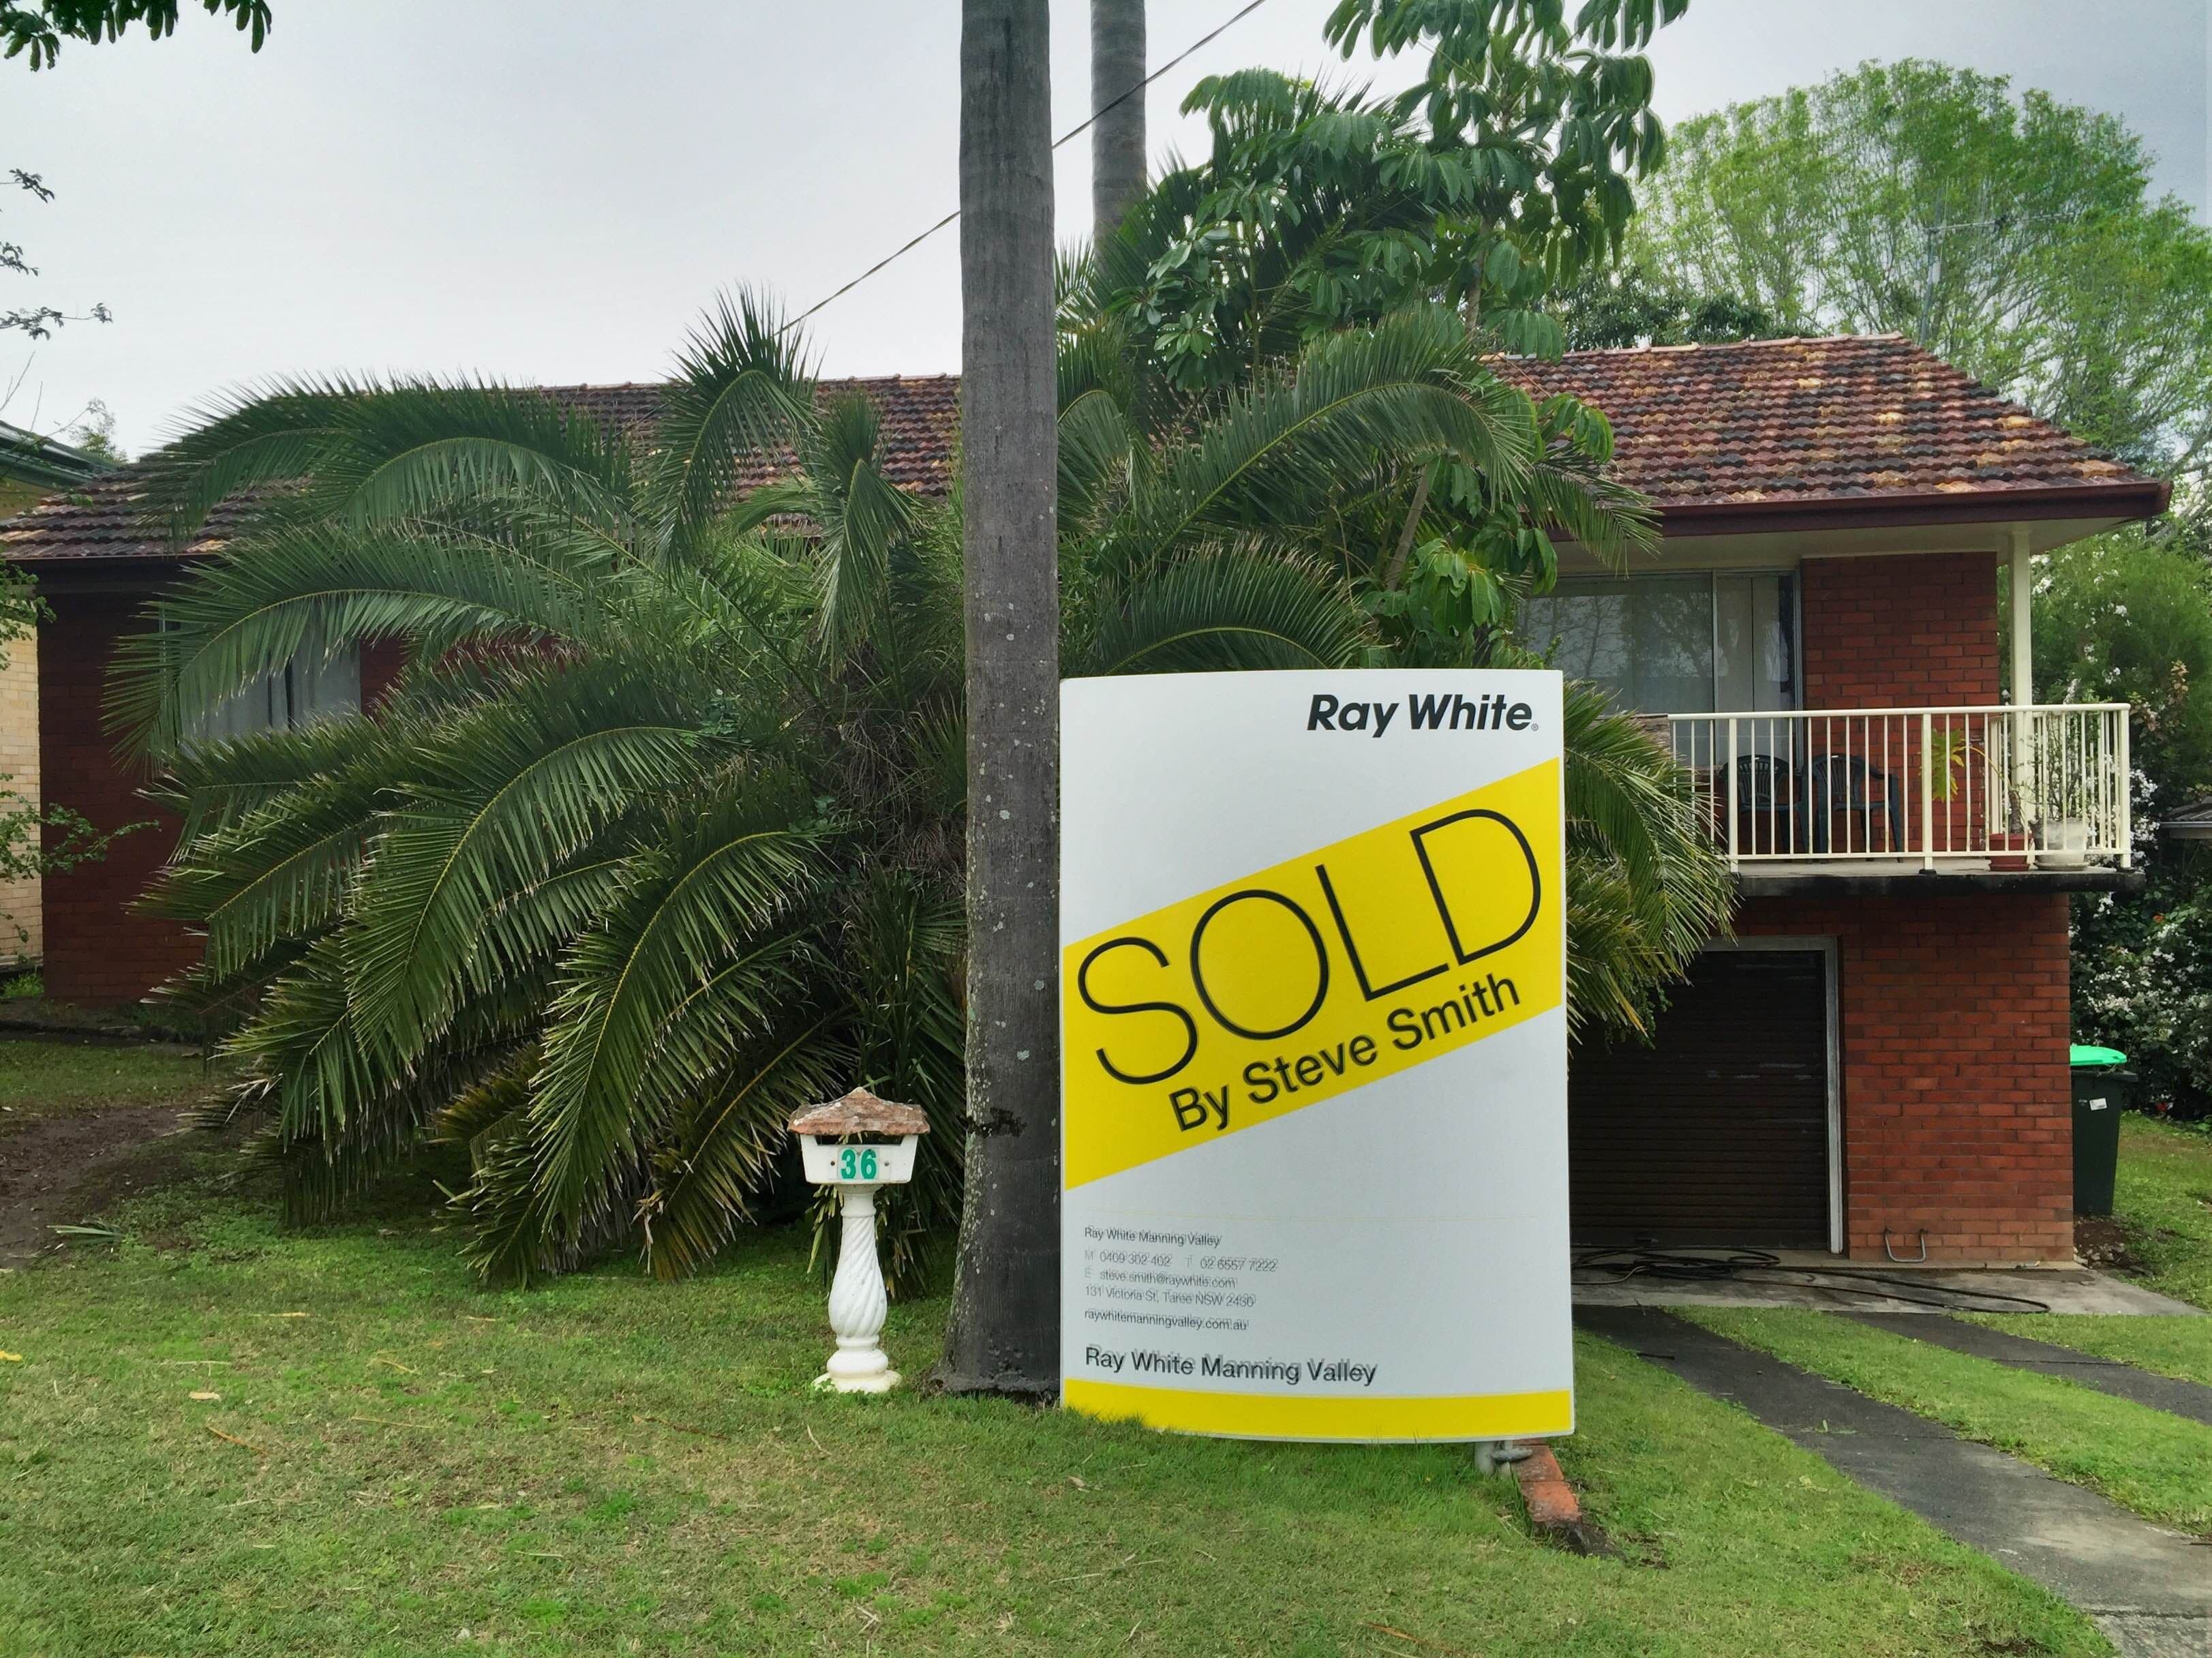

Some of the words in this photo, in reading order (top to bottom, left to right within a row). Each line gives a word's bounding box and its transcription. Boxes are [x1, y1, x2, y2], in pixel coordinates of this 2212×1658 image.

[1307, 694, 1399, 738] Ray
[1078, 809, 1541, 1085] SOLD
[1168, 1085, 1231, 1132] By
[1243, 1034, 1378, 1104] Steve
[1387, 972, 1521, 1051] Smith
[840, 1148, 877, 1179] 36
[1085, 1226, 1103, 1241] Ray
[1106, 1228, 1136, 1241] White
[1139, 1231, 1185, 1247] Manning
[1187, 1233, 1221, 1248] Valley
[1085, 1250, 1093, 1261] M
[1100, 1251, 1126, 1263] 0409
[1151, 1254, 1171, 1267] 402
[1200, 1257, 1215, 1269] 02
[1085, 1285, 1102, 1297] 131
[1106, 1286, 1142, 1301] Victoria
[1162, 1291, 1192, 1304] Taree
[1195, 1293, 1223, 1306] NSW
[1226, 1295, 1255, 1308] 2430
[1085, 1309, 1247, 1330] raywhitemanningvalley.com.au
[1085, 1346, 1125, 1373] Ray
[1131, 1351, 1194, 1375] White
[1201, 1356, 1303, 1385] Manning
[1306, 1357, 1377, 1387] Valley
